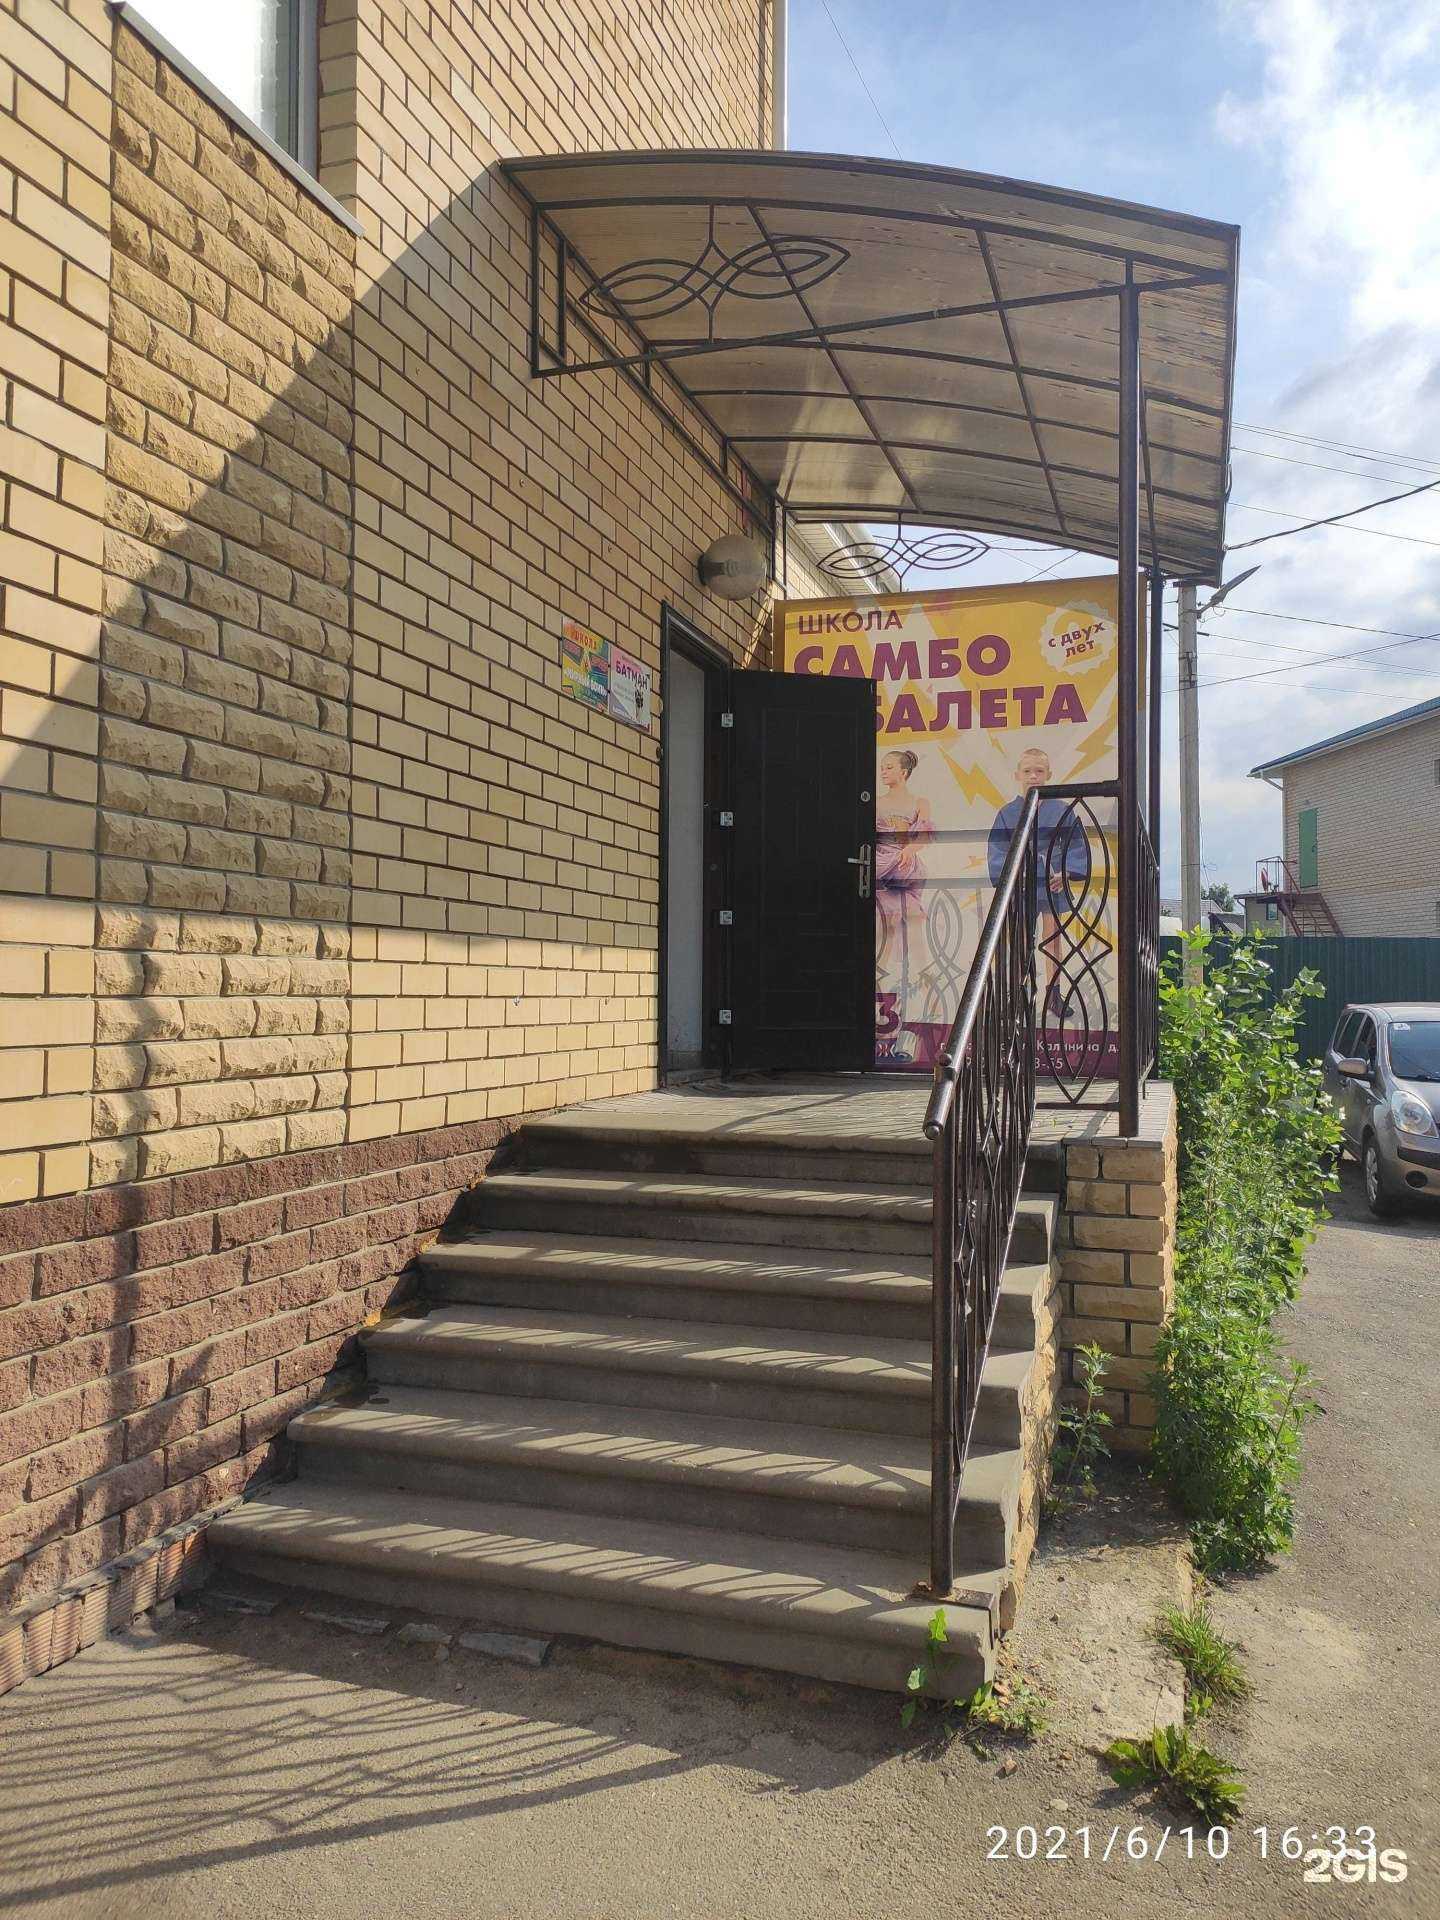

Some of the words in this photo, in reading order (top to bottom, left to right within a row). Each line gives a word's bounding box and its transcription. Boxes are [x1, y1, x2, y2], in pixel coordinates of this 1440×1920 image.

[798, 609, 903, 635] ШКОЛА
[793, 634, 1012, 682] САМБО
[1065, 639, 1095, 658] лет
[876, 683, 1089, 734] АЛЕТА
